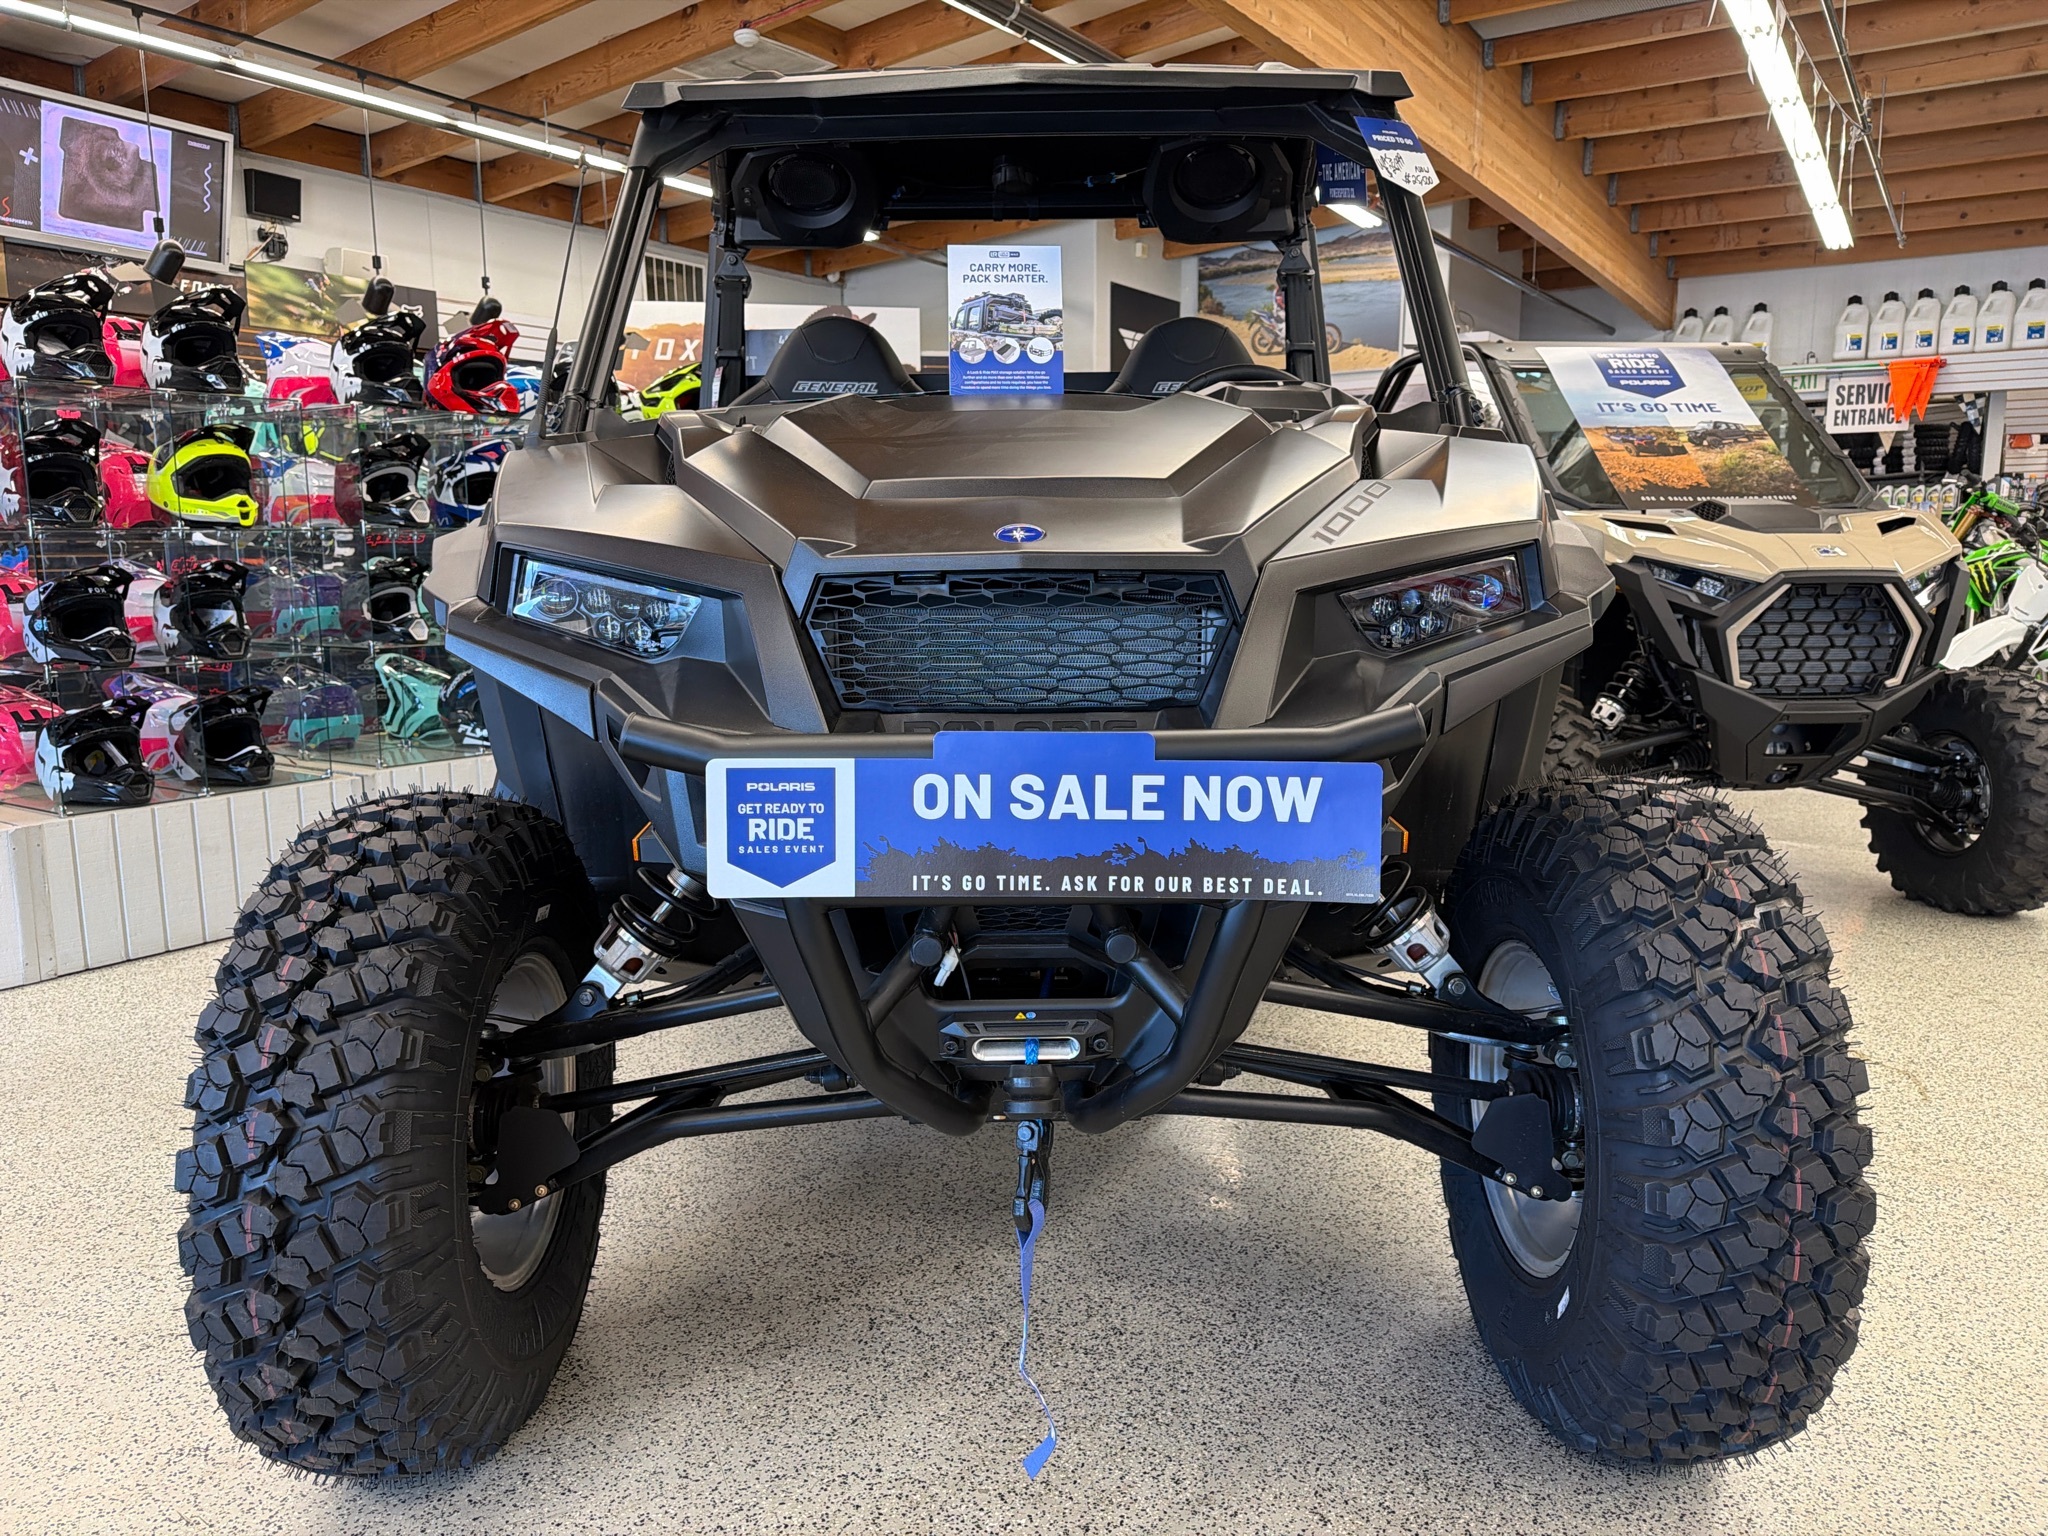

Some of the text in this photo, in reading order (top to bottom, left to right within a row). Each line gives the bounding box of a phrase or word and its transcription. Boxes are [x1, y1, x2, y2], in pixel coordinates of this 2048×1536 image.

[1372, 134, 1414, 146] PRICED TO GO
[1322, 161, 1361, 182] THE AMERICAN
[969, 263, 1041, 273] CARRY MORE.
[962, 274, 1049, 284] PACK SMARTER.
[1608, 358, 1661, 369] RIDE
[792, 380, 879, 394] GENERAL
[1597, 402, 1722, 413] IT'S GO TIME
[1311, 481, 1393, 546] 1000
[746, 782, 816, 792] POLARIS
[912, 773, 1323, 823] ON SALE NOW
[737, 803, 825, 815] GET READY TO
[748, 817, 815, 842] RIDE
[738, 845, 825, 854] SALES EVENT
[912, 874, 1323, 897] IT'S GO TIME. ASK FOR OUR BEST DEAL.
